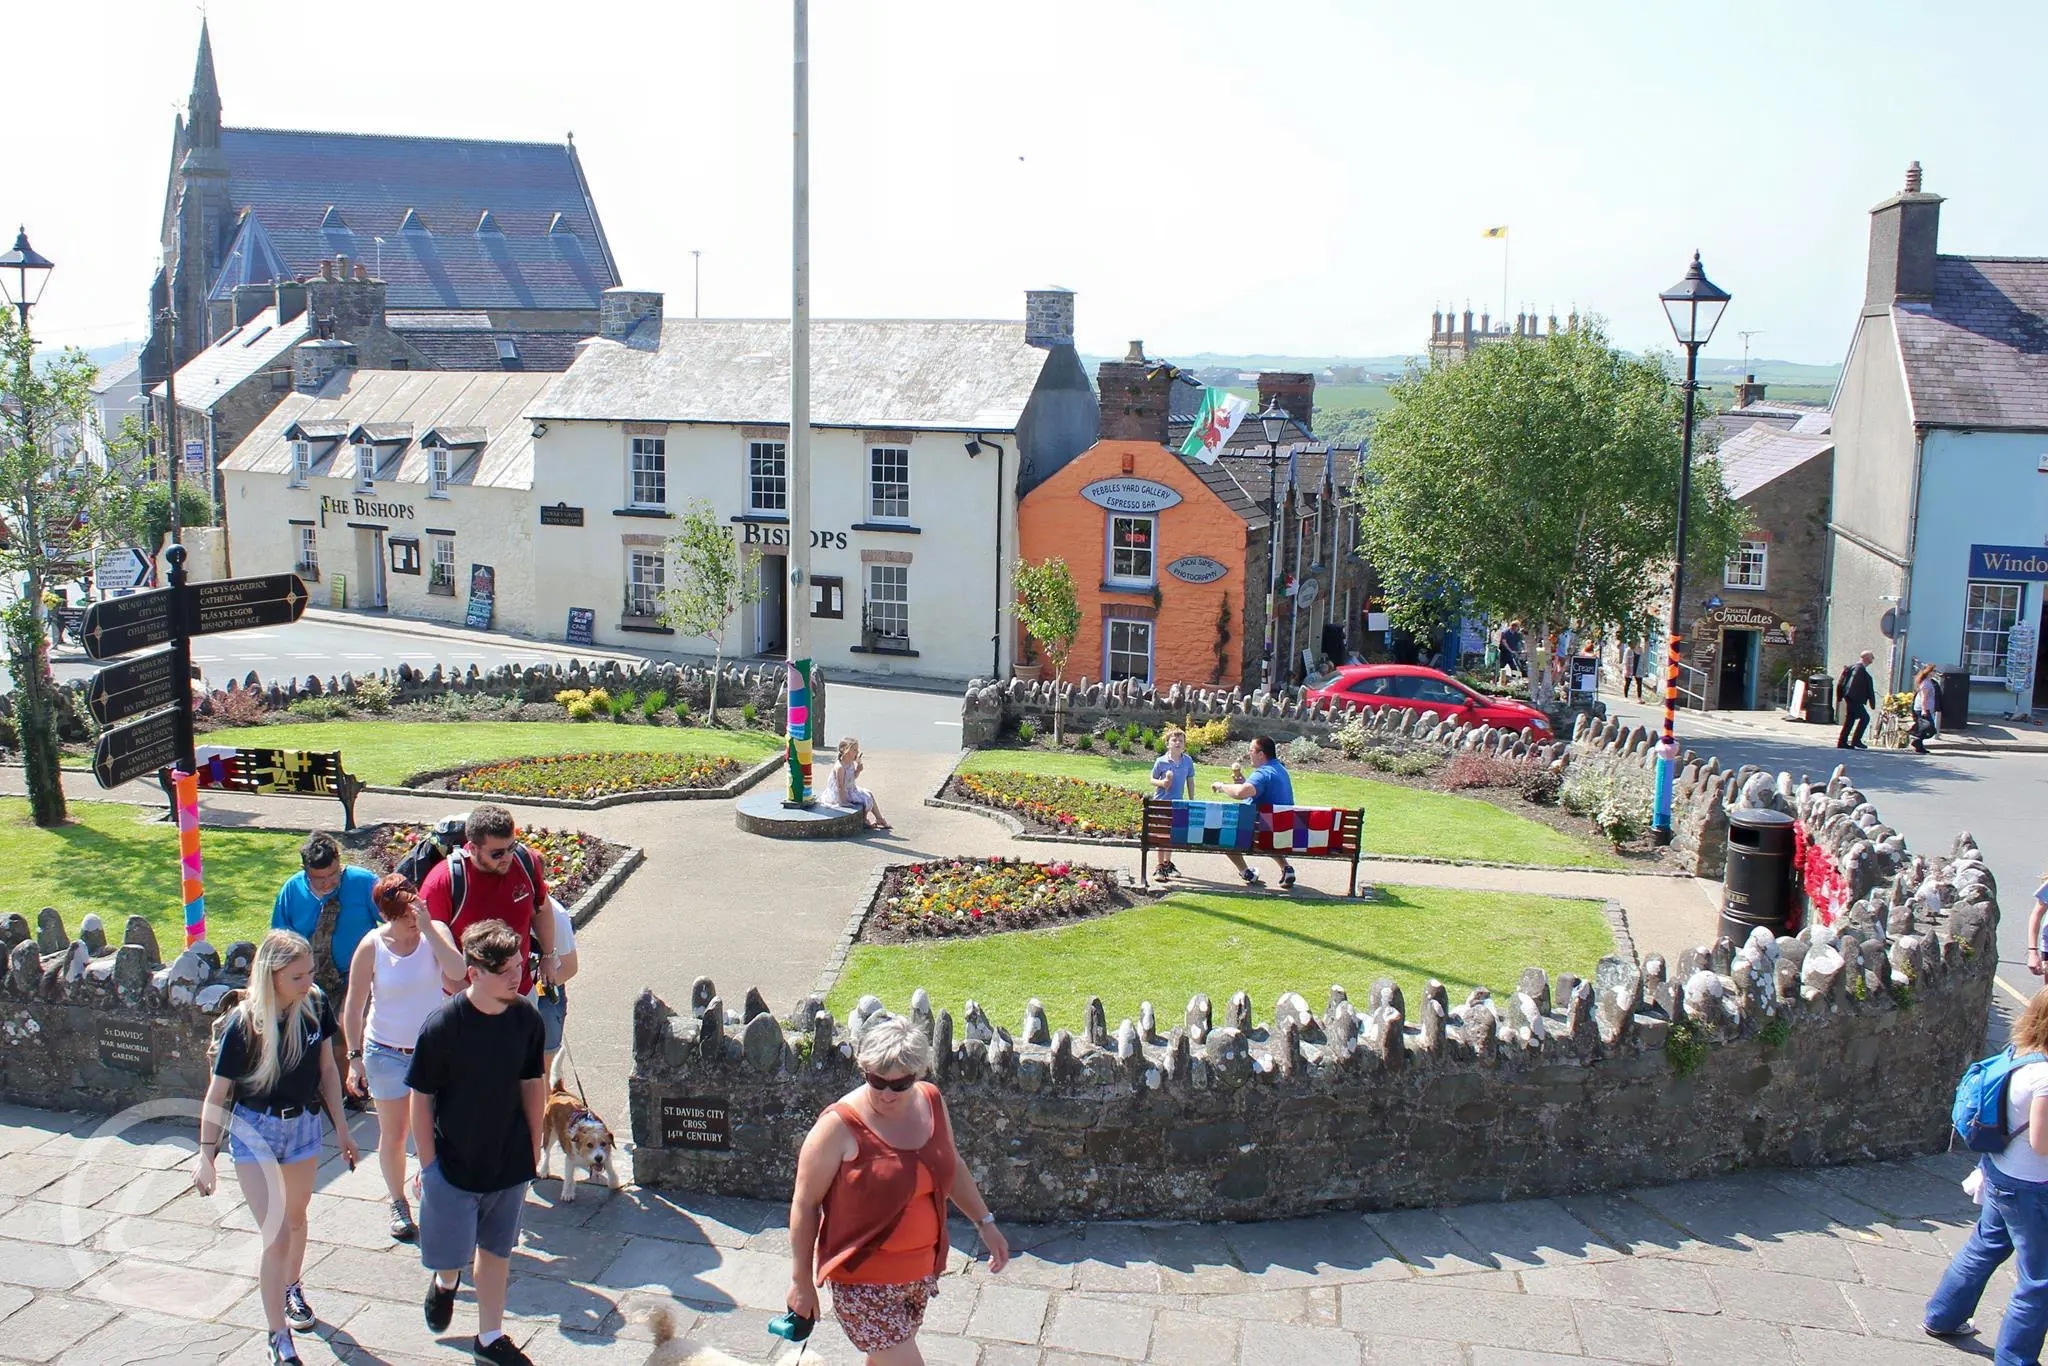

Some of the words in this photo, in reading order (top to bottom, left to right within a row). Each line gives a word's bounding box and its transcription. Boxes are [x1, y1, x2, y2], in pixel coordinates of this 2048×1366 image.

[1092, 484, 1121, 497] PEBBLES
[1121, 484, 1140, 493] YARD
[1141, 485, 1171, 500] GALLERY
[320, 495, 349, 514] THE
[354, 498, 415, 520] BISHOPS
[1106, 497, 1140, 509] ESPRESSO
[1141, 500, 1157, 509] BAR
[1983, 553, 2048, 574] Windo
[1173, 568, 1217, 580] PHOTOGRAPHY
[200, 585, 228, 596] EGLWYS
[200, 594, 243, 605] CATHEDRAL
[229, 607, 254, 617] ESGOB
[1714, 607, 1773, 624] Chocolates
[114, 1029, 144, 1041] DAVIDS
[100, 1039, 115, 1048] WAR
[116, 1042, 151, 1053] MEMORIAL
[112, 1052, 140, 1062] GARDEN
[676, 1108, 705, 1118] DAVIDS
[706, 1109, 725, 1119] CITY
[683, 1120, 707, 1129] CROSS
[687, 1131, 723, 1143] CENTURY
